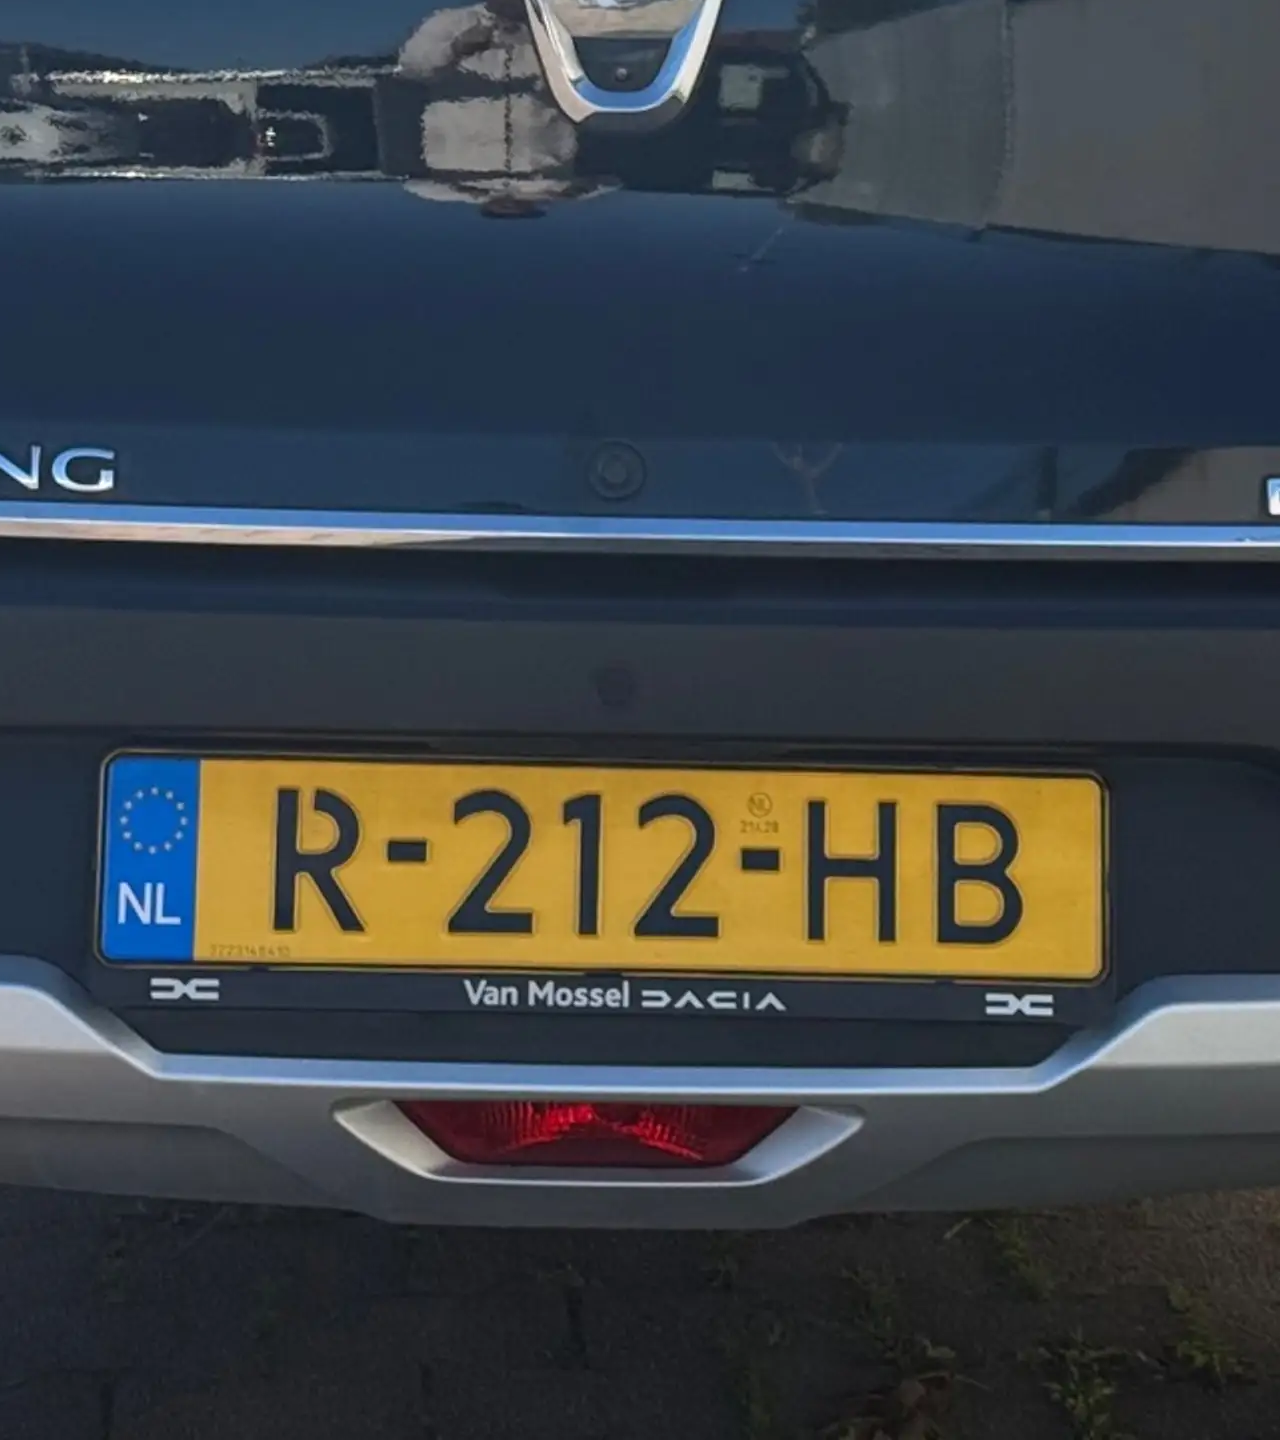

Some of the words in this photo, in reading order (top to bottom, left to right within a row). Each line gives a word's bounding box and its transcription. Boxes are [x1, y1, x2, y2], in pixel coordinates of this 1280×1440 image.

[272, 787, 1024, 944] R-212-HB
[117, 881, 182, 925] NL
[463, 979, 518, 1006] Van
[527, 980, 630, 1008] Mossel
[641, 989, 787, 1011] DACIA
